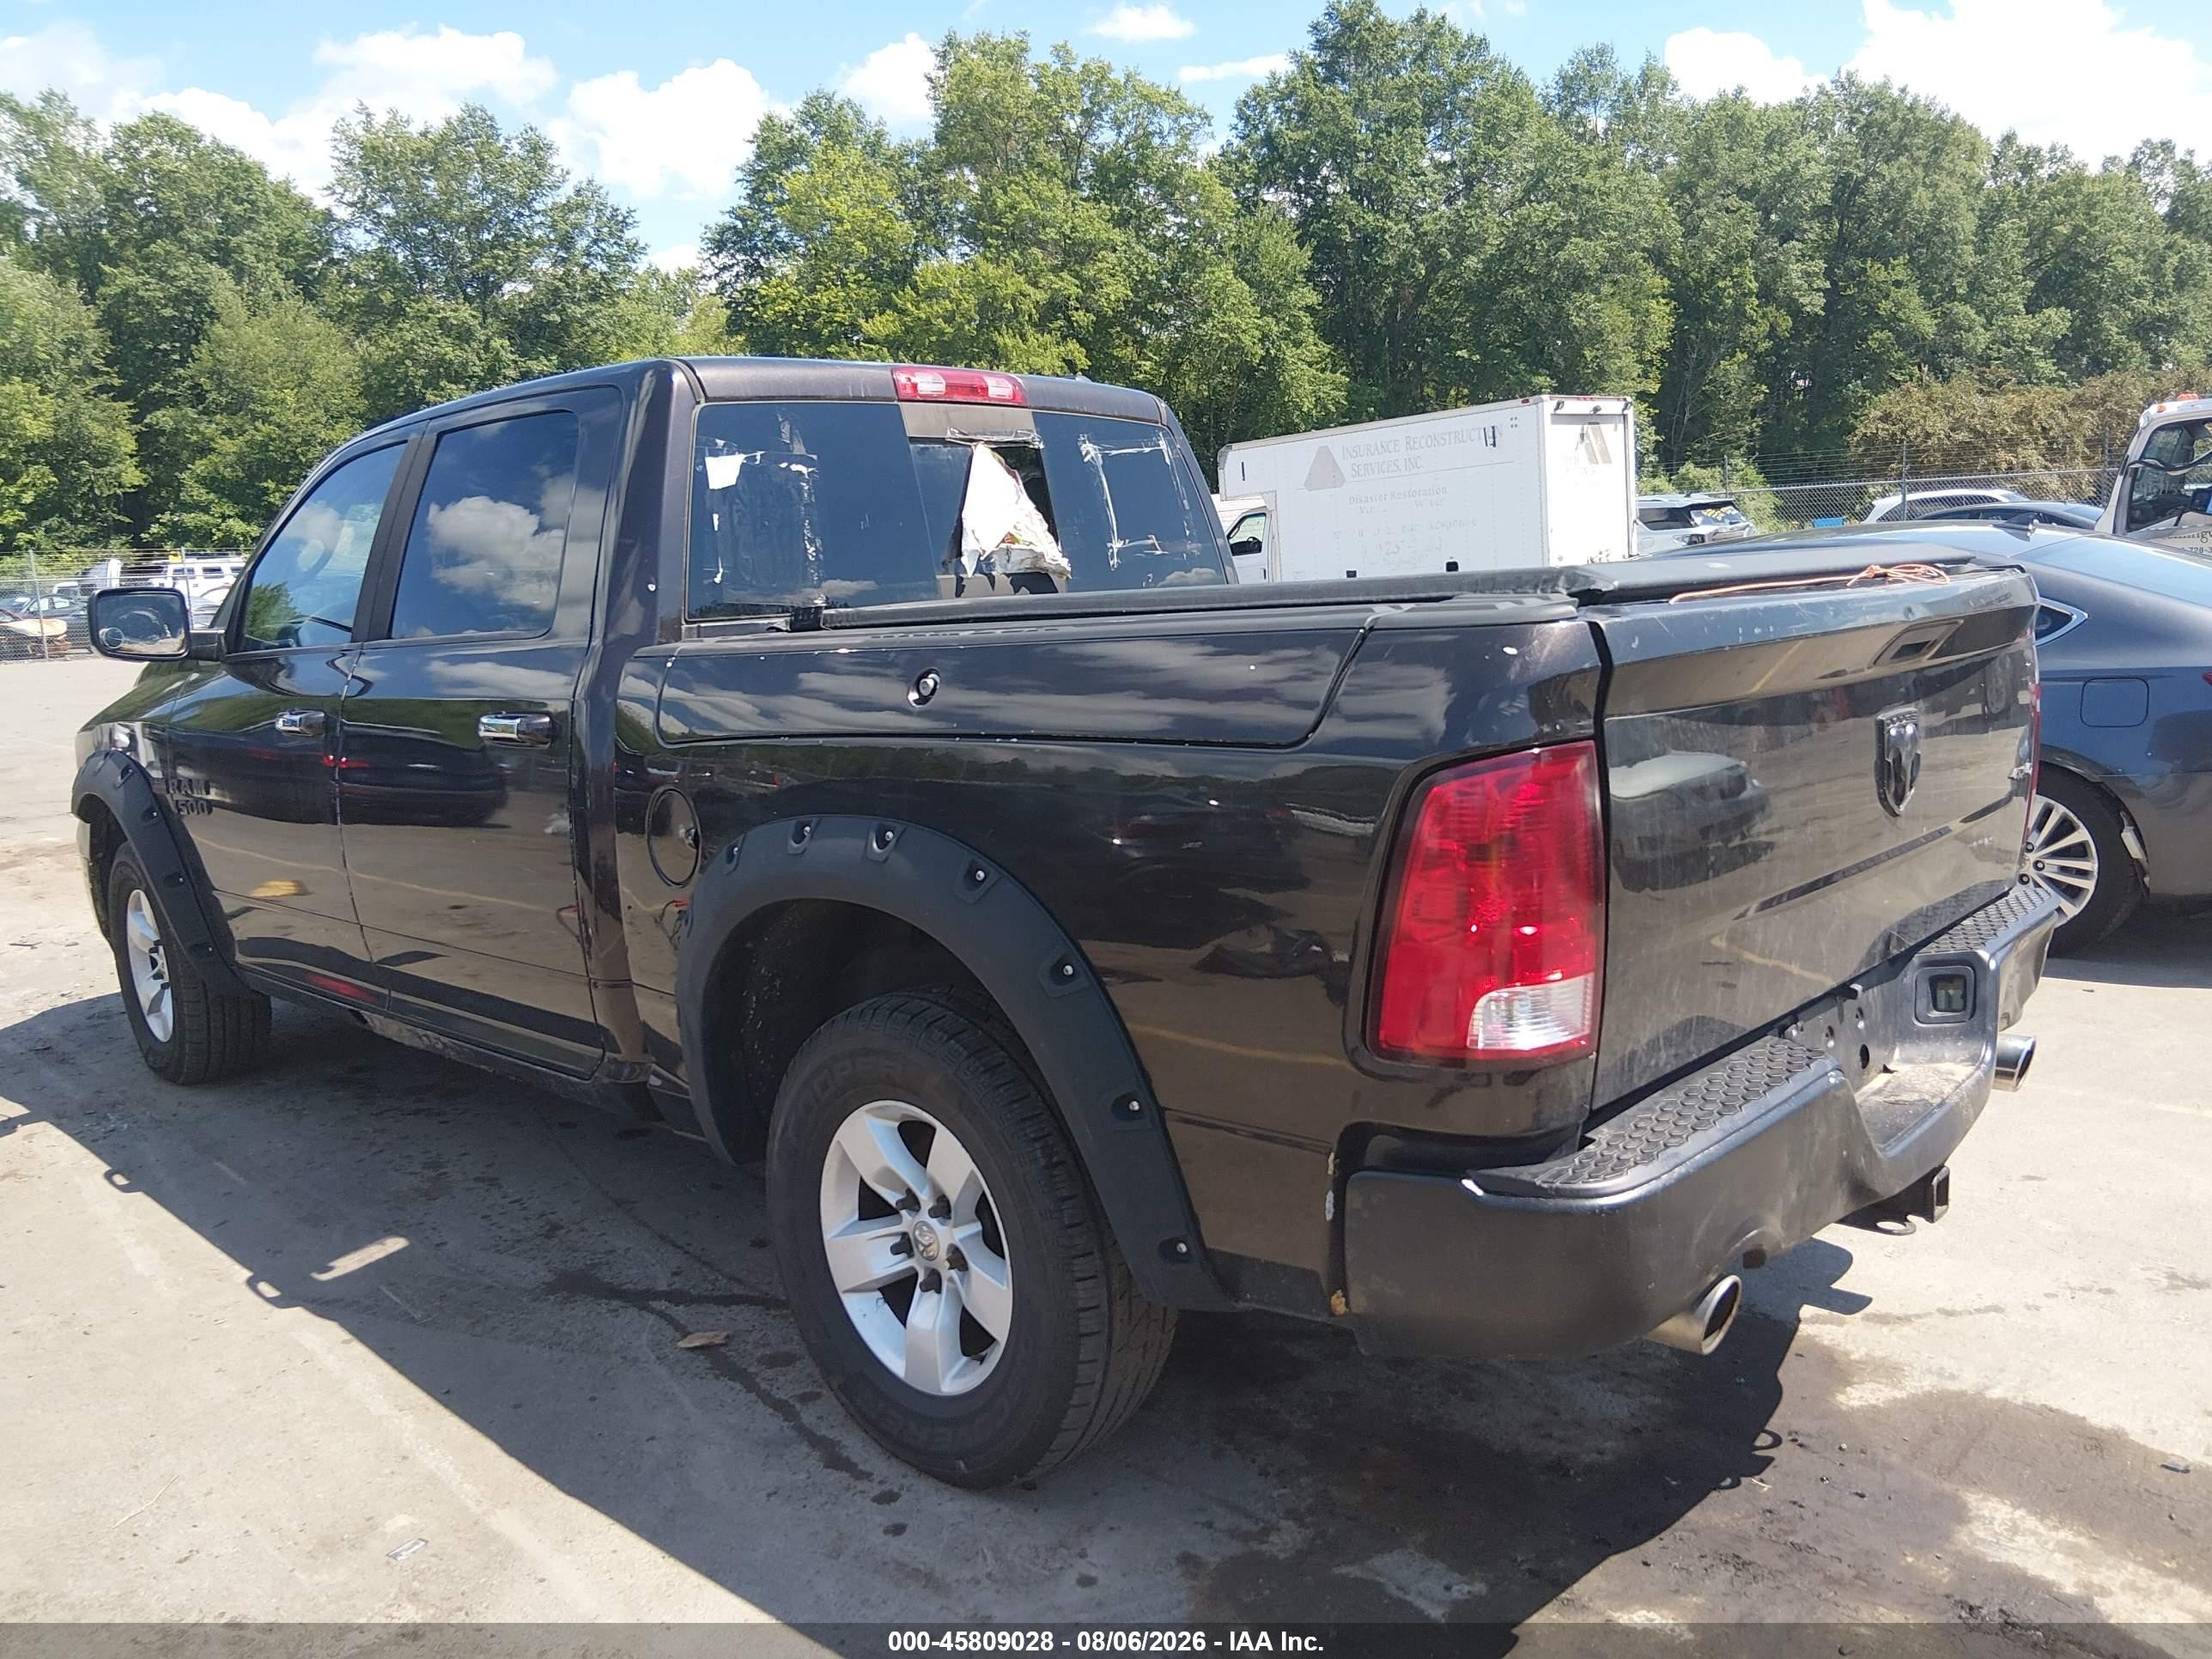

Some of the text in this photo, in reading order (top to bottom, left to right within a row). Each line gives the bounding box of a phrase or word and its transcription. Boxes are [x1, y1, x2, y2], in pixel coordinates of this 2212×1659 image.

[1342, 424, 1504, 461] INSURANCE RECONSTRUCTON
[1352, 456, 1424, 478] SERVICES, INC.
[1348, 493, 1388, 507] Disaster
[1389, 486, 1449, 502] Restoration
[167, 776, 210, 795] RAM
